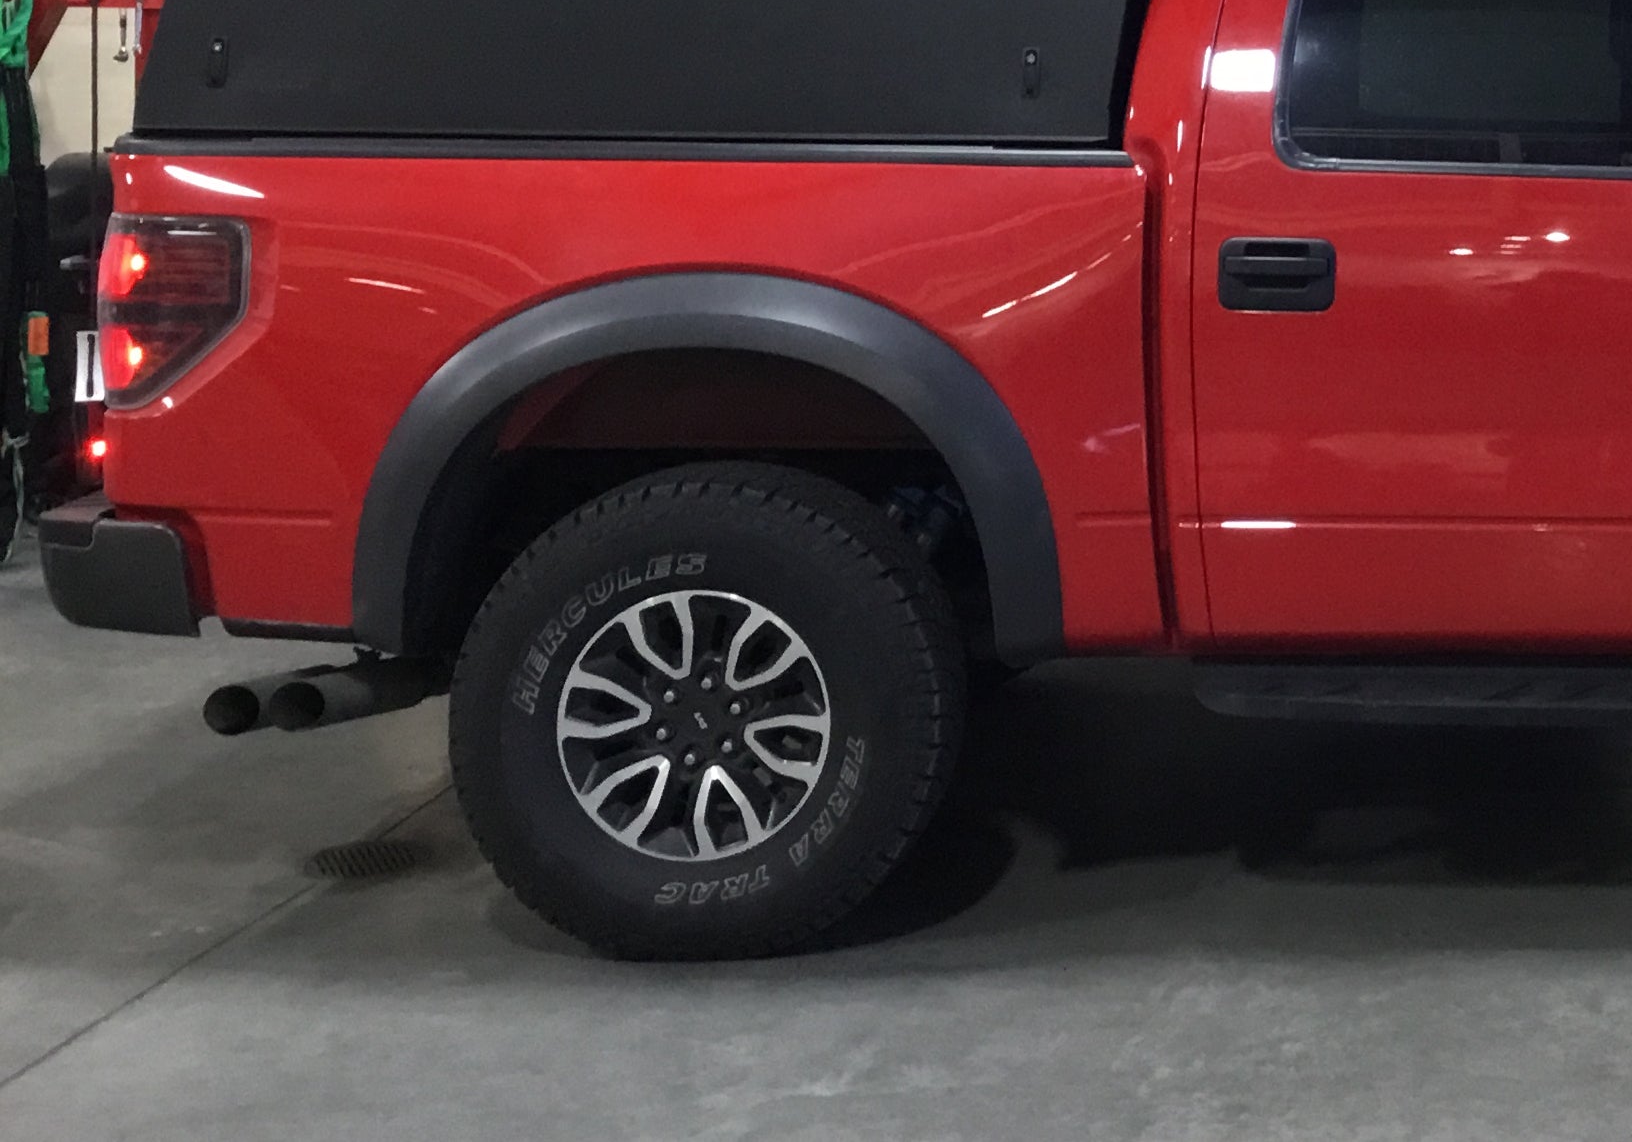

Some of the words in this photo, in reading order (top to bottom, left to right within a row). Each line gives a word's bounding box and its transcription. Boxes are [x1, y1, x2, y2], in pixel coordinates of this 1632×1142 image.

[512, 553, 707, 715] HERCULES
[788, 736, 865, 866] TERRA
[653, 864, 770, 905] TRAC
